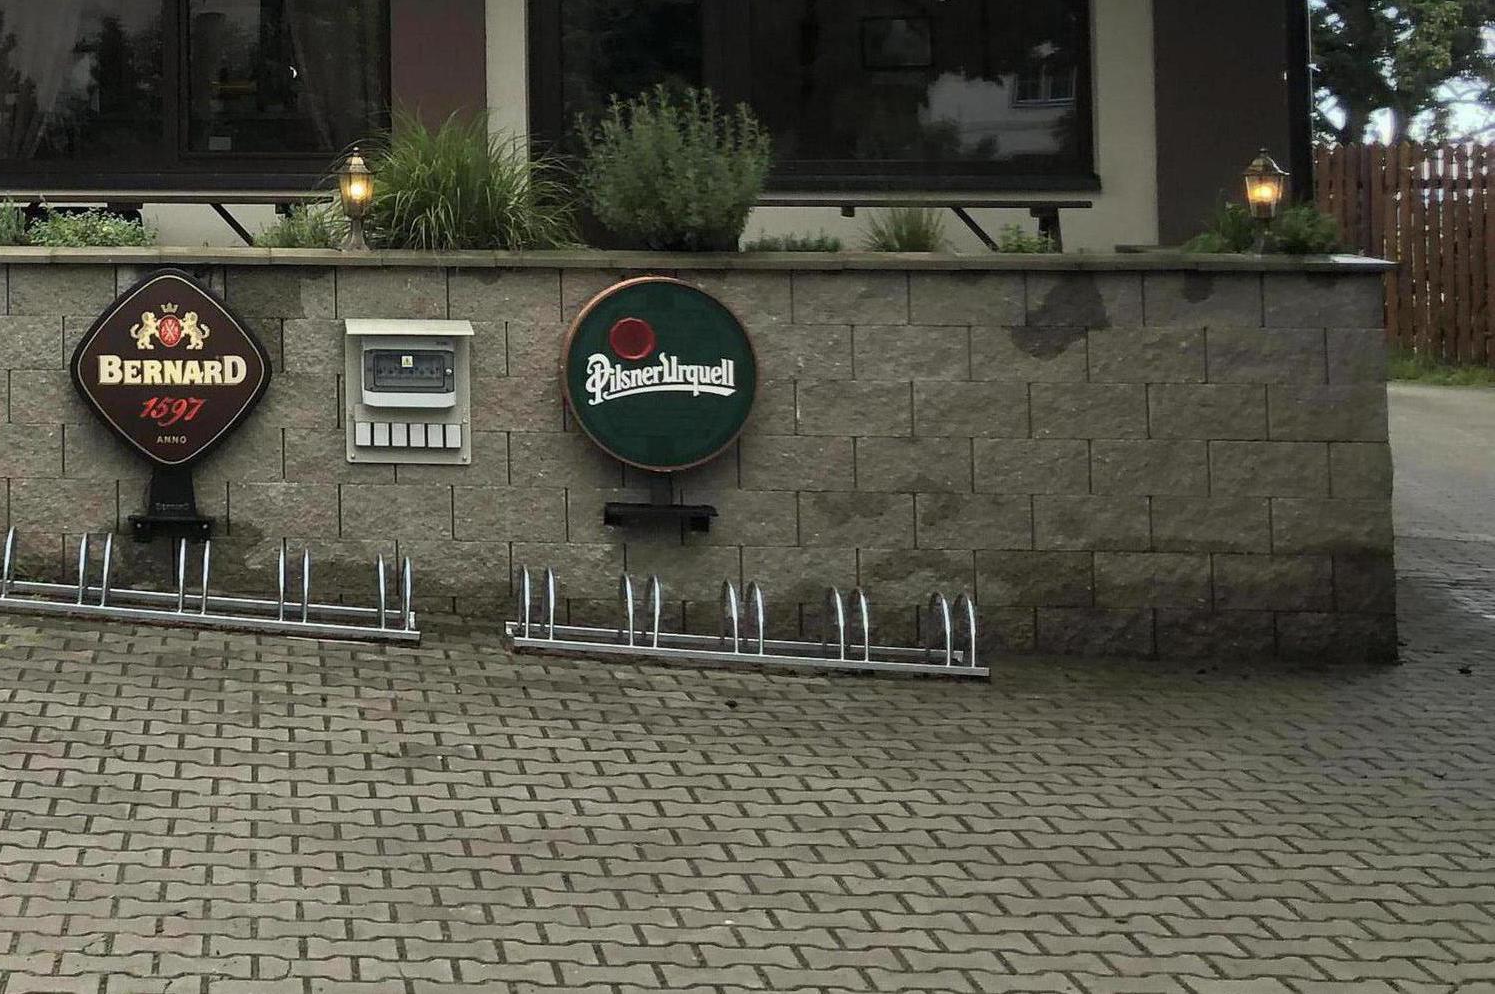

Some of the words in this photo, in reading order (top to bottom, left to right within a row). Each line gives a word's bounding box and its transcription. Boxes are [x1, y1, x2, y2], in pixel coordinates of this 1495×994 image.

[98, 354, 247, 386] BERNARD
[585, 353, 664, 406] Pilsner
[659, 352, 735, 397] Urquell
[140, 396, 205, 427] 1597
[156, 435, 187, 444] ANNO
